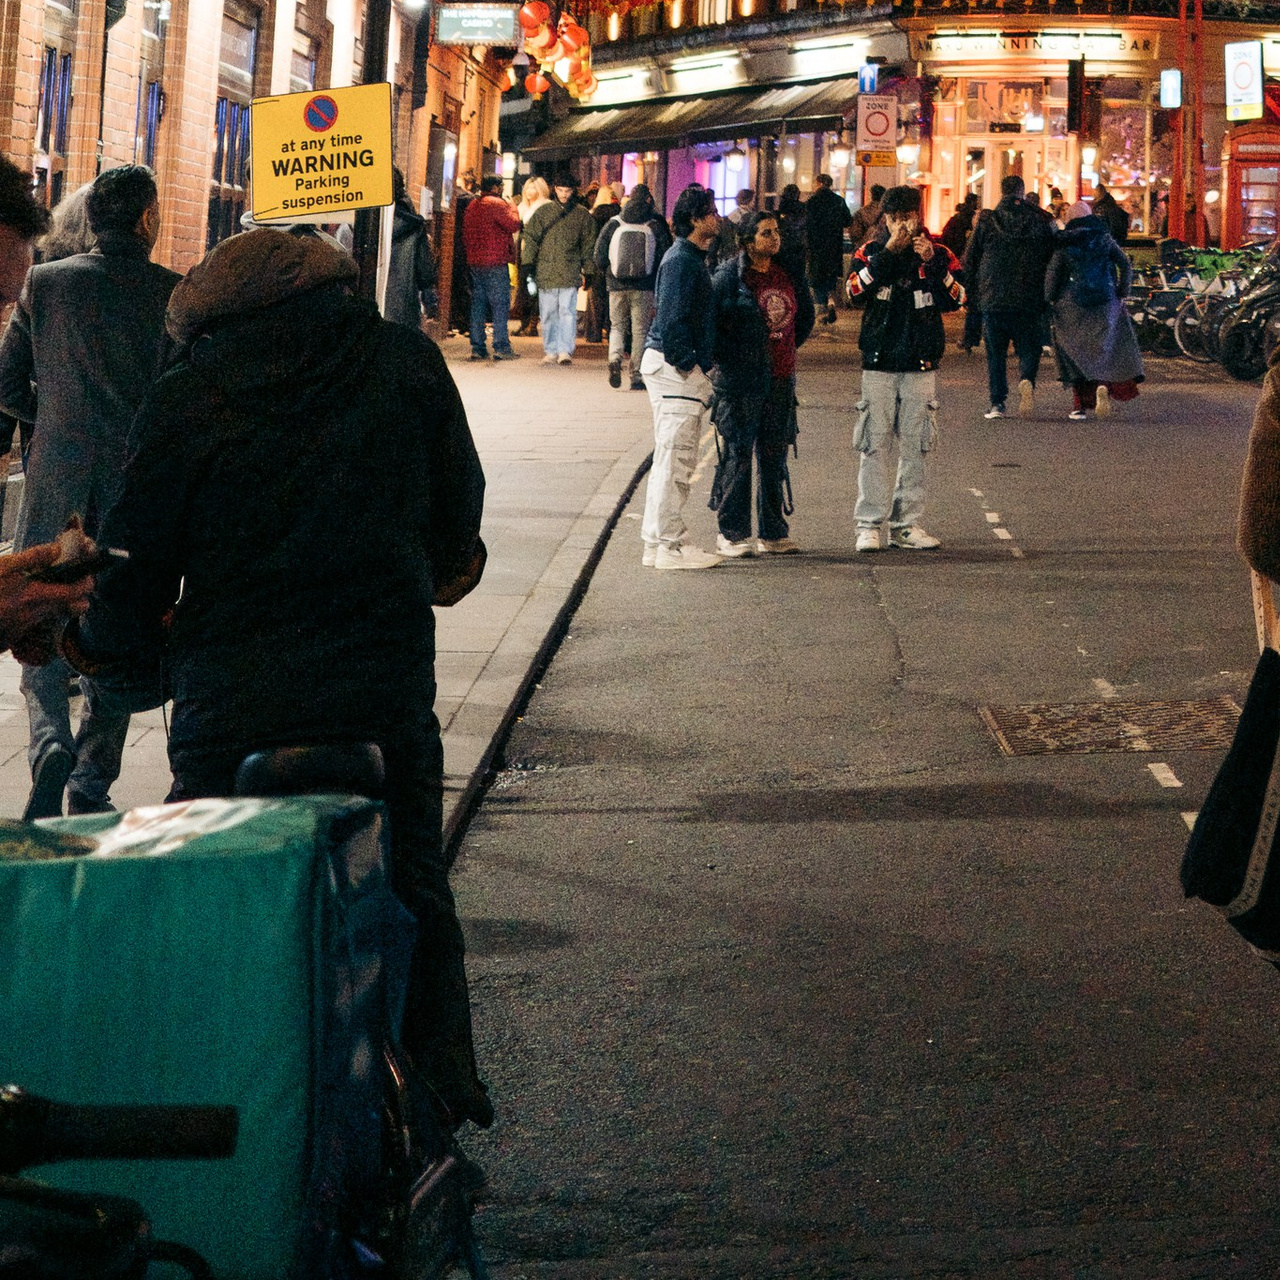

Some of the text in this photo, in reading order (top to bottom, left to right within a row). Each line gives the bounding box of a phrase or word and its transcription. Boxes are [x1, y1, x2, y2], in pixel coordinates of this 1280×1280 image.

[1119, 39, 1151, 52] BAR
[866, 102, 889, 111] ZONE
[281, 134, 363, 153] at any time
[271, 149, 374, 177] WARNING
[295, 175, 350, 191] Parking
[281, 190, 364, 210] suspension
